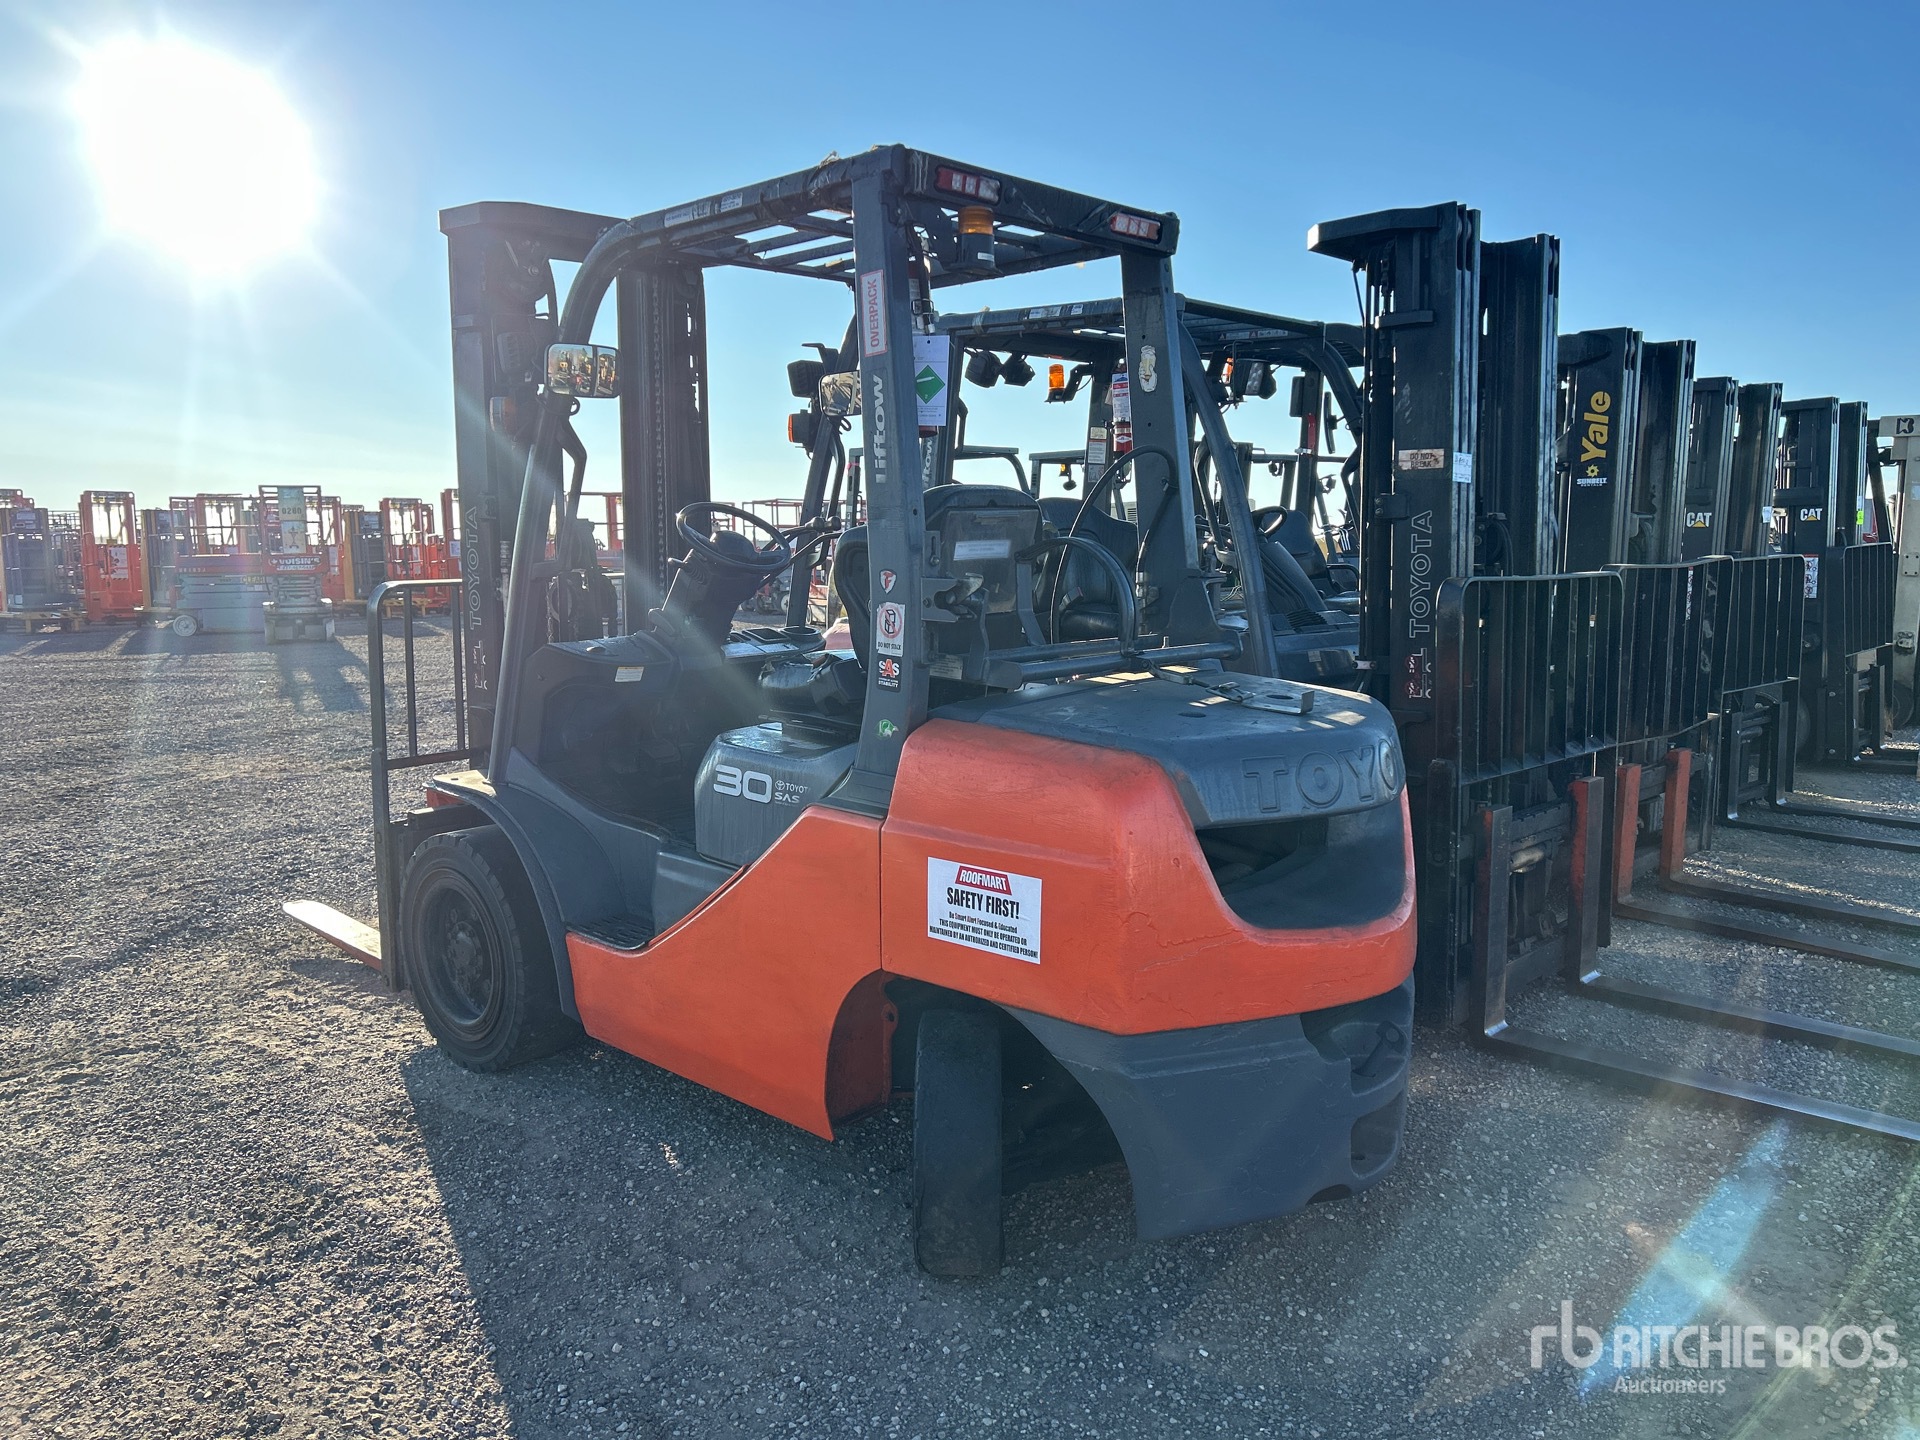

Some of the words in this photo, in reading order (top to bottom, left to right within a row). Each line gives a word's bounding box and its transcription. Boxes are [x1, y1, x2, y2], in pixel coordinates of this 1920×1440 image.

[868, 278, 880, 348] OVERPACK
[1580, 391, 1611, 462] Yale
[1576, 477, 1608, 485] SUNBELT
[1686, 512, 1712, 528] CAT
[1800, 508, 1823, 521] CAT
[465, 506, 482, 630] TOYOTA
[1409, 510, 1433, 638] TOYOTA
[878, 658, 900, 678] SAS
[713, 764, 773, 804] 30
[774, 792, 800, 804] SAS
[959, 869, 1007, 891] ROOFMART
[946, 887, 983, 911] SAFETY
[985, 895, 1020, 920] FIRST!
[939, 918, 948, 928] THIS
[949, 920, 971, 932] EQUIPMENT
[971, 925, 984, 935] MUST
[984, 928, 994, 938] ONLY
[994, 930, 999, 939] BE
[1000, 931, 1020, 945] OPERATED
[1021, 938, 1027, 946] OR
[990, 939, 998, 949] AND
